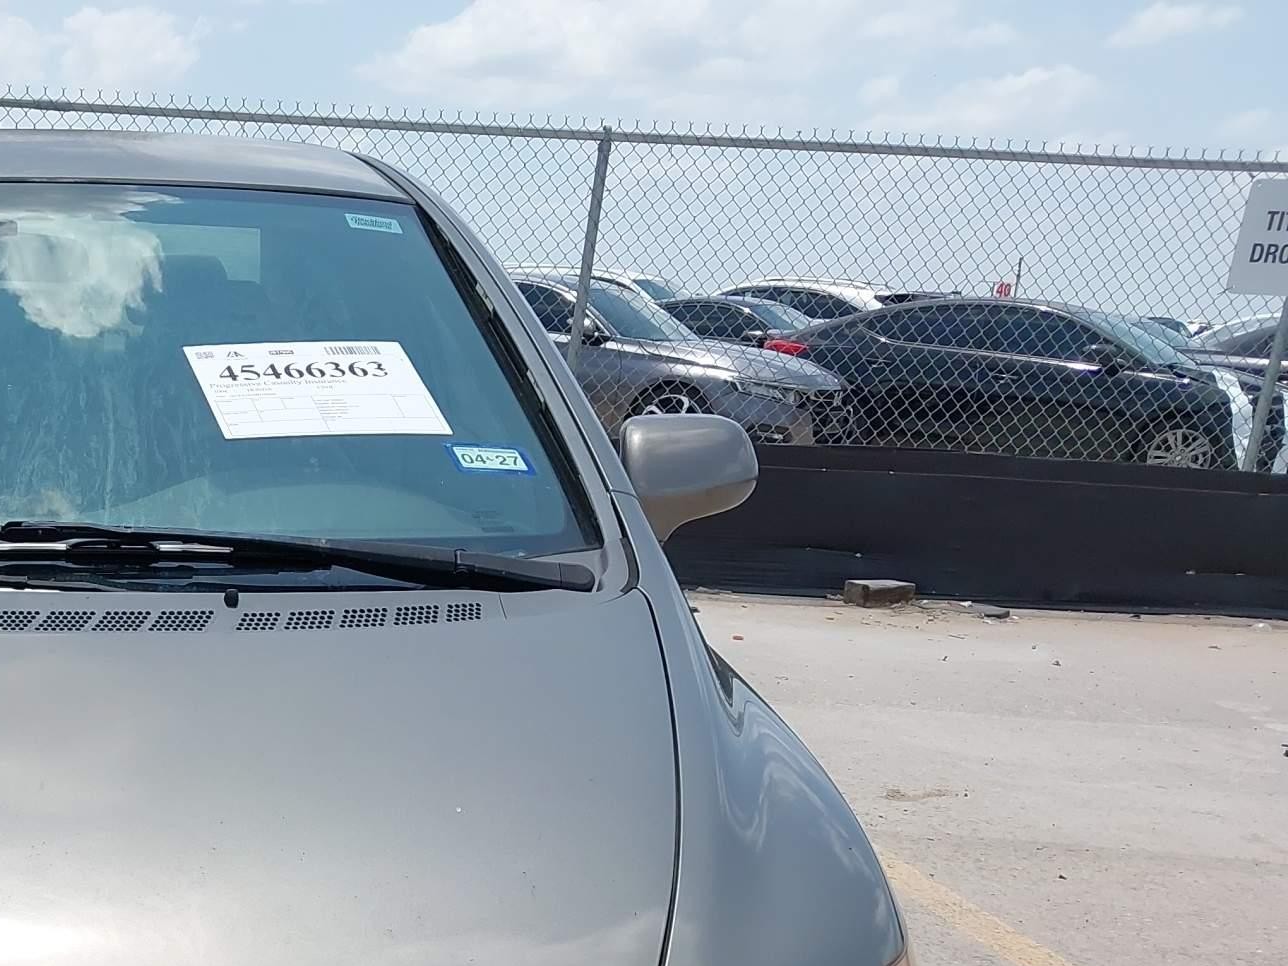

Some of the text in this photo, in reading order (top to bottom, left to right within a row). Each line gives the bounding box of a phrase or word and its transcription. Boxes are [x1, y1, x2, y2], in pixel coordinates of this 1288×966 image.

[1267, 211, 1288, 231] TI
[996, 283, 1011, 298] 40
[219, 361, 389, 382] 45466363
